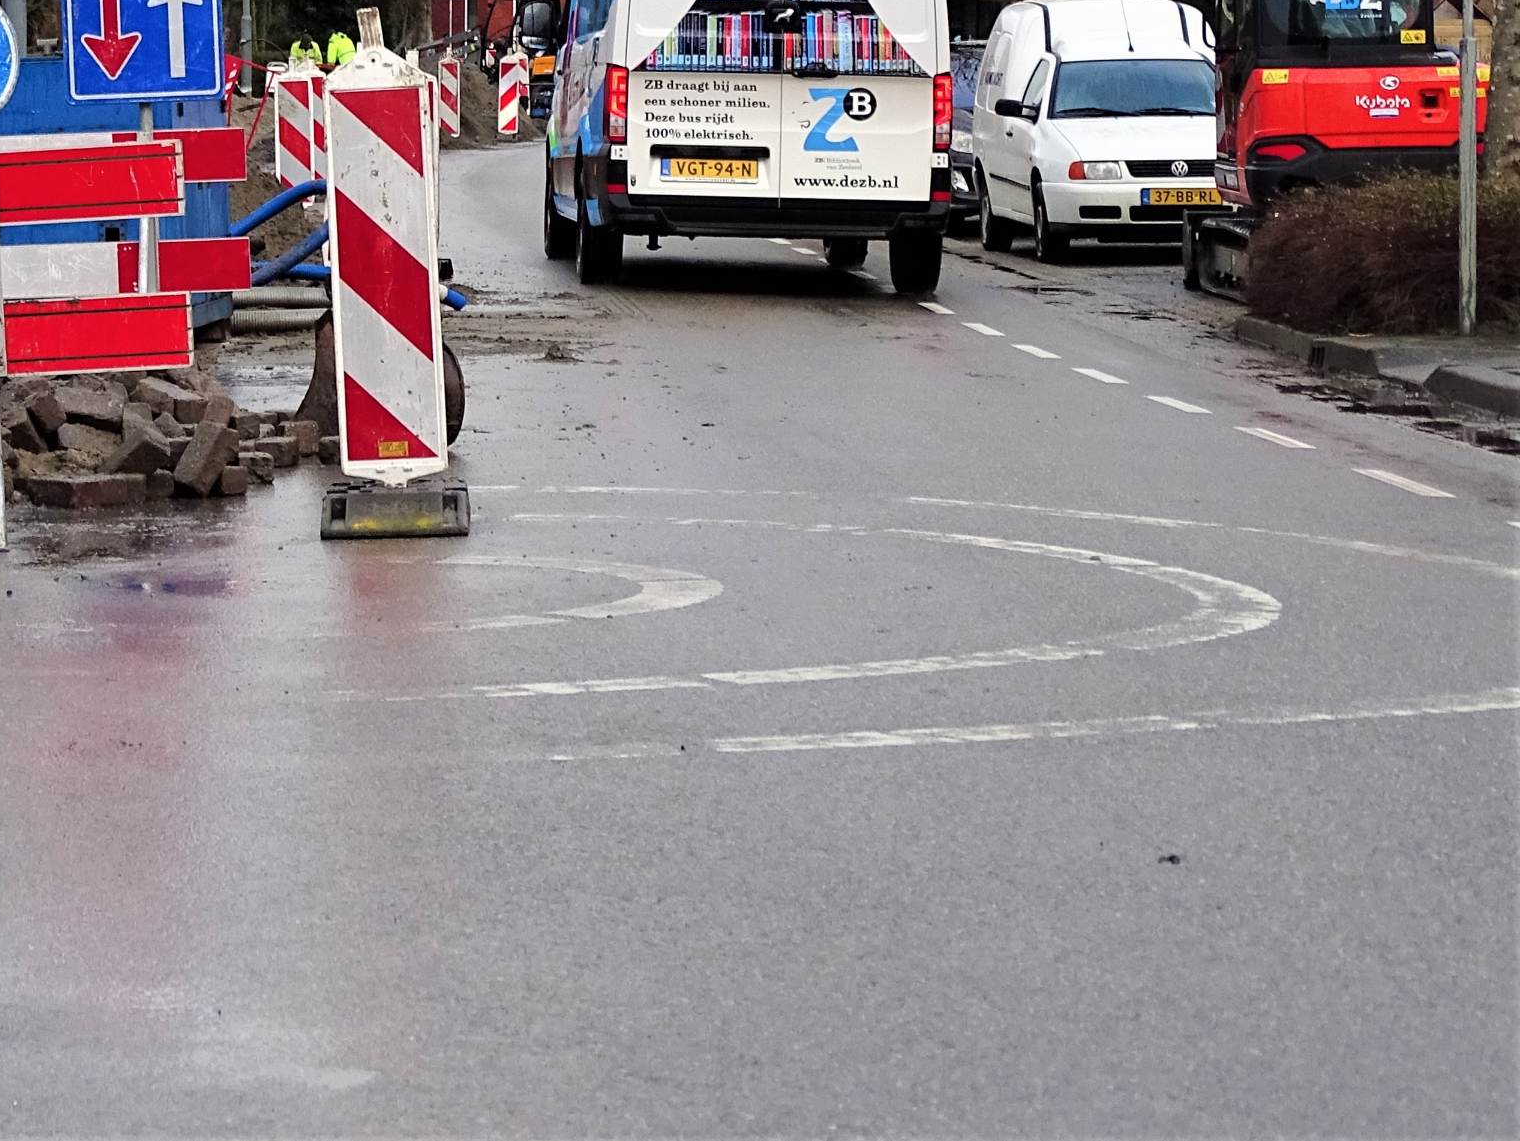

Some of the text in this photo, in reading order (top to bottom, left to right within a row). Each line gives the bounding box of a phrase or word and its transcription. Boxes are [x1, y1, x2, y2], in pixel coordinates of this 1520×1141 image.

[644, 79, 757, 93] ZB draagt bij aan
[644, 96, 770, 109] een schoner milieu.
[1355, 95, 1410, 109] Kubota
[645, 112, 735, 125] Deze bus rijdt
[803, 87, 874, 152] ZB
[646, 128, 754, 141] 100% elektrisch.
[676, 161, 752, 177] VGT-94-N
[794, 174, 899, 189] www.dezb.nl
[1154, 190, 1217, 203] 37-BB-RL
